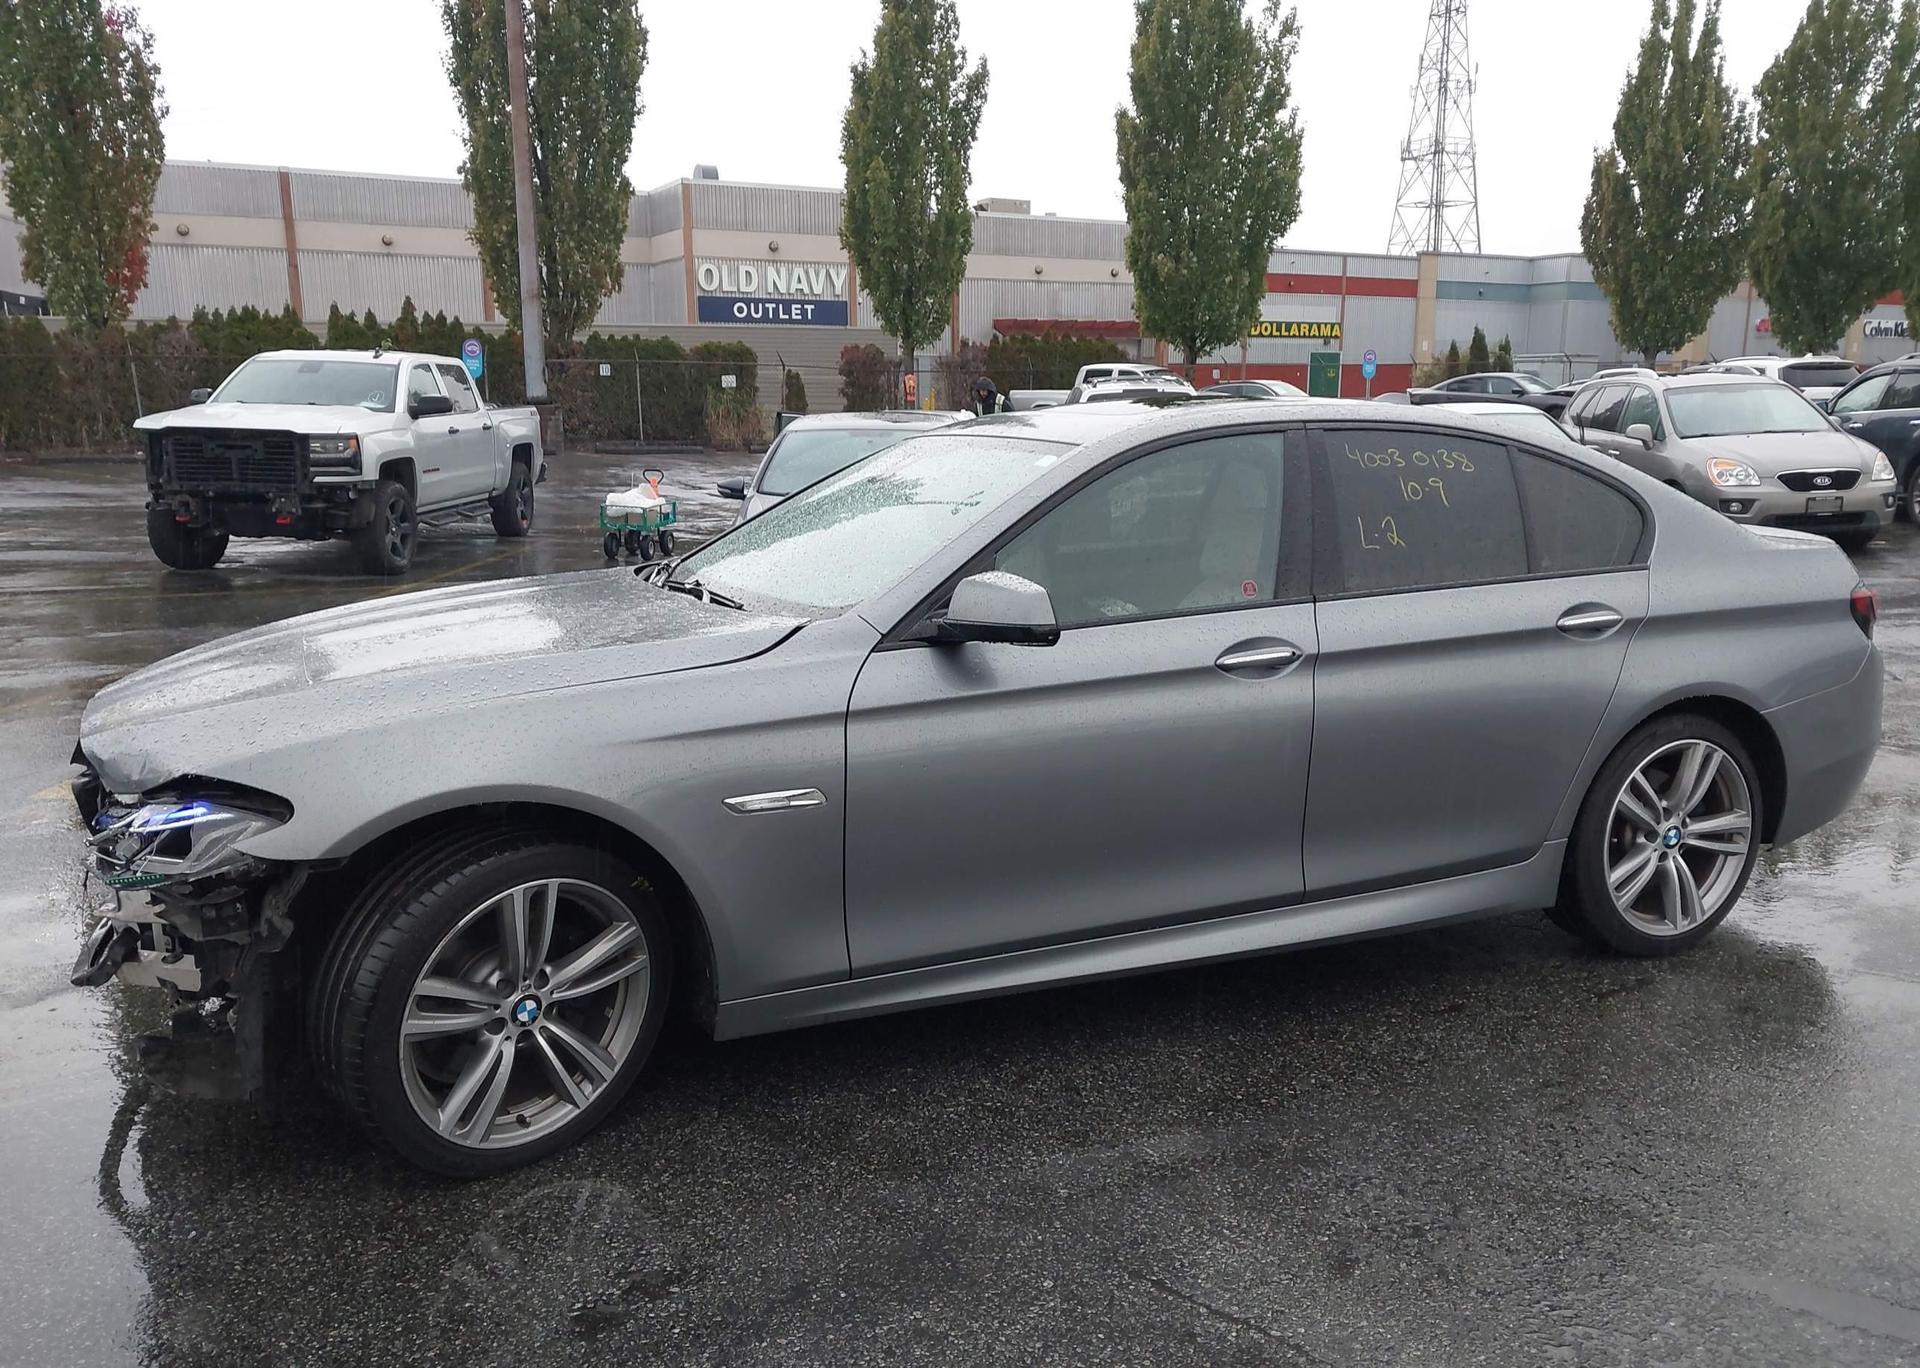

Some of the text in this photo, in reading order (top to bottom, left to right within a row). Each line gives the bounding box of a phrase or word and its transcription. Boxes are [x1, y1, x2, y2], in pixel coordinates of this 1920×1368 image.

[698, 263, 848, 296] OLD NAVY
[733, 302, 816, 320] OUTLET
[1250, 322, 1341, 337] DOLLARAMA
[1863, 320, 1910, 337] Calvin Kle
[1345, 442, 1475, 472] 4003 0138
